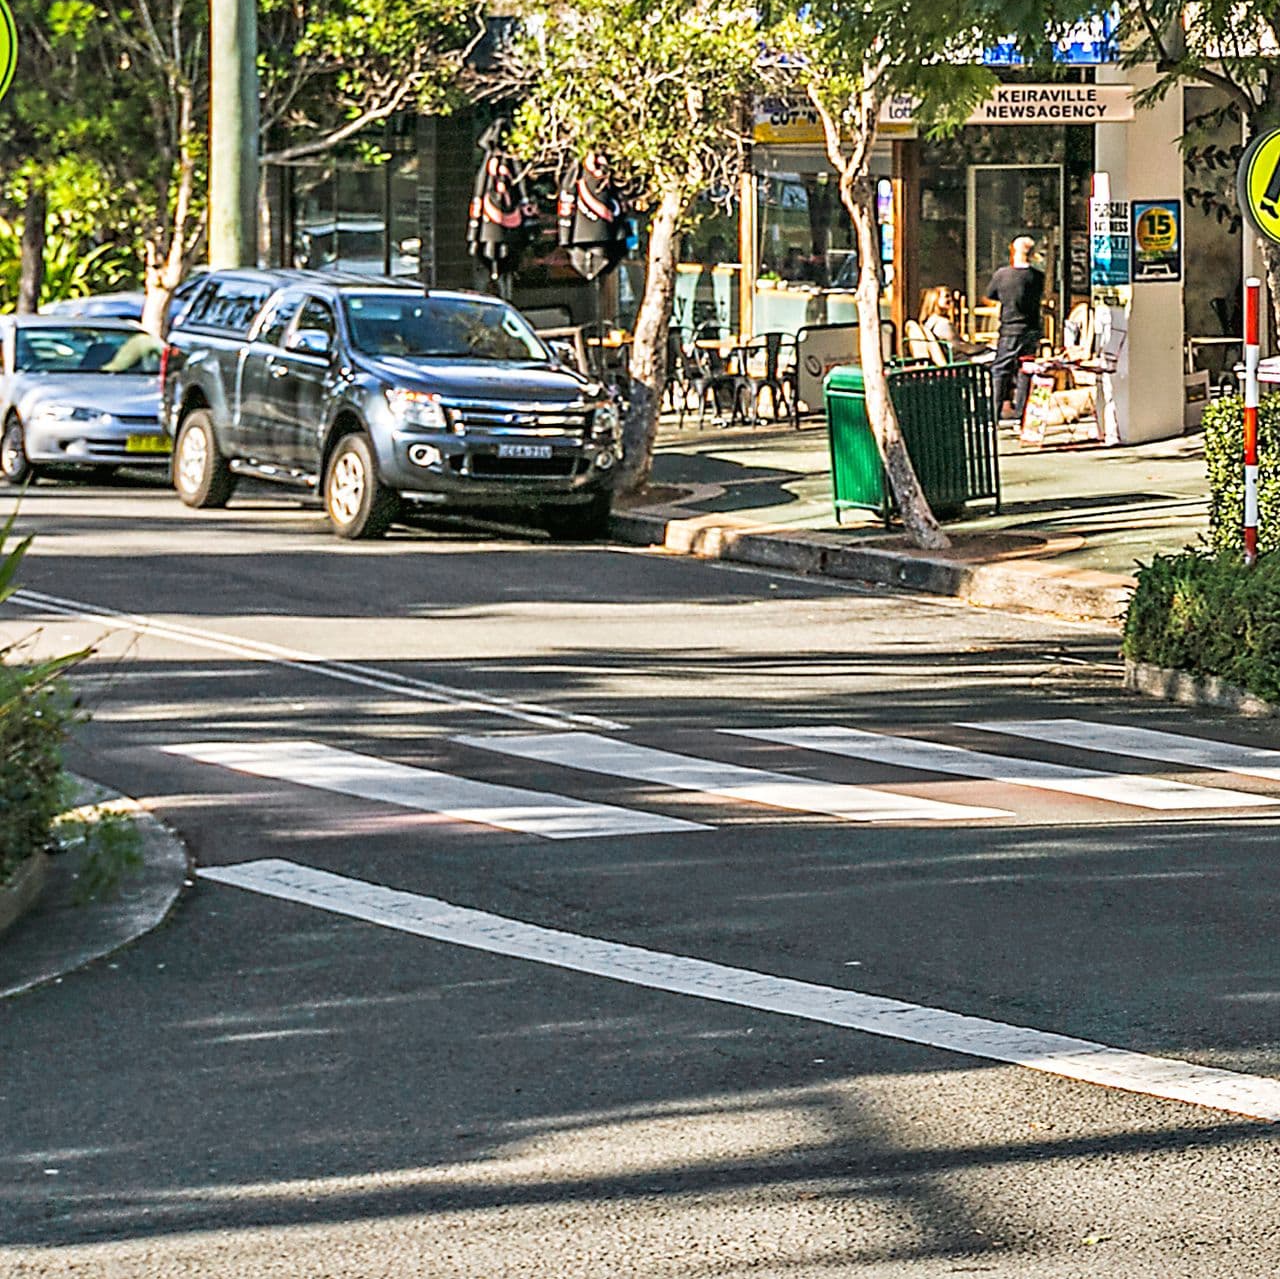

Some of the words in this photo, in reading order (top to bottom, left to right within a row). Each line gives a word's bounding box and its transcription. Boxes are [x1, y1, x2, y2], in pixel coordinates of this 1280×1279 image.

[998, 89, 1097, 102] KEIRAVILLE
[770, 111, 799, 126] CUT
[986, 105, 1107, 118] NEWSAGENCY
[1145, 214, 1171, 235] 15
